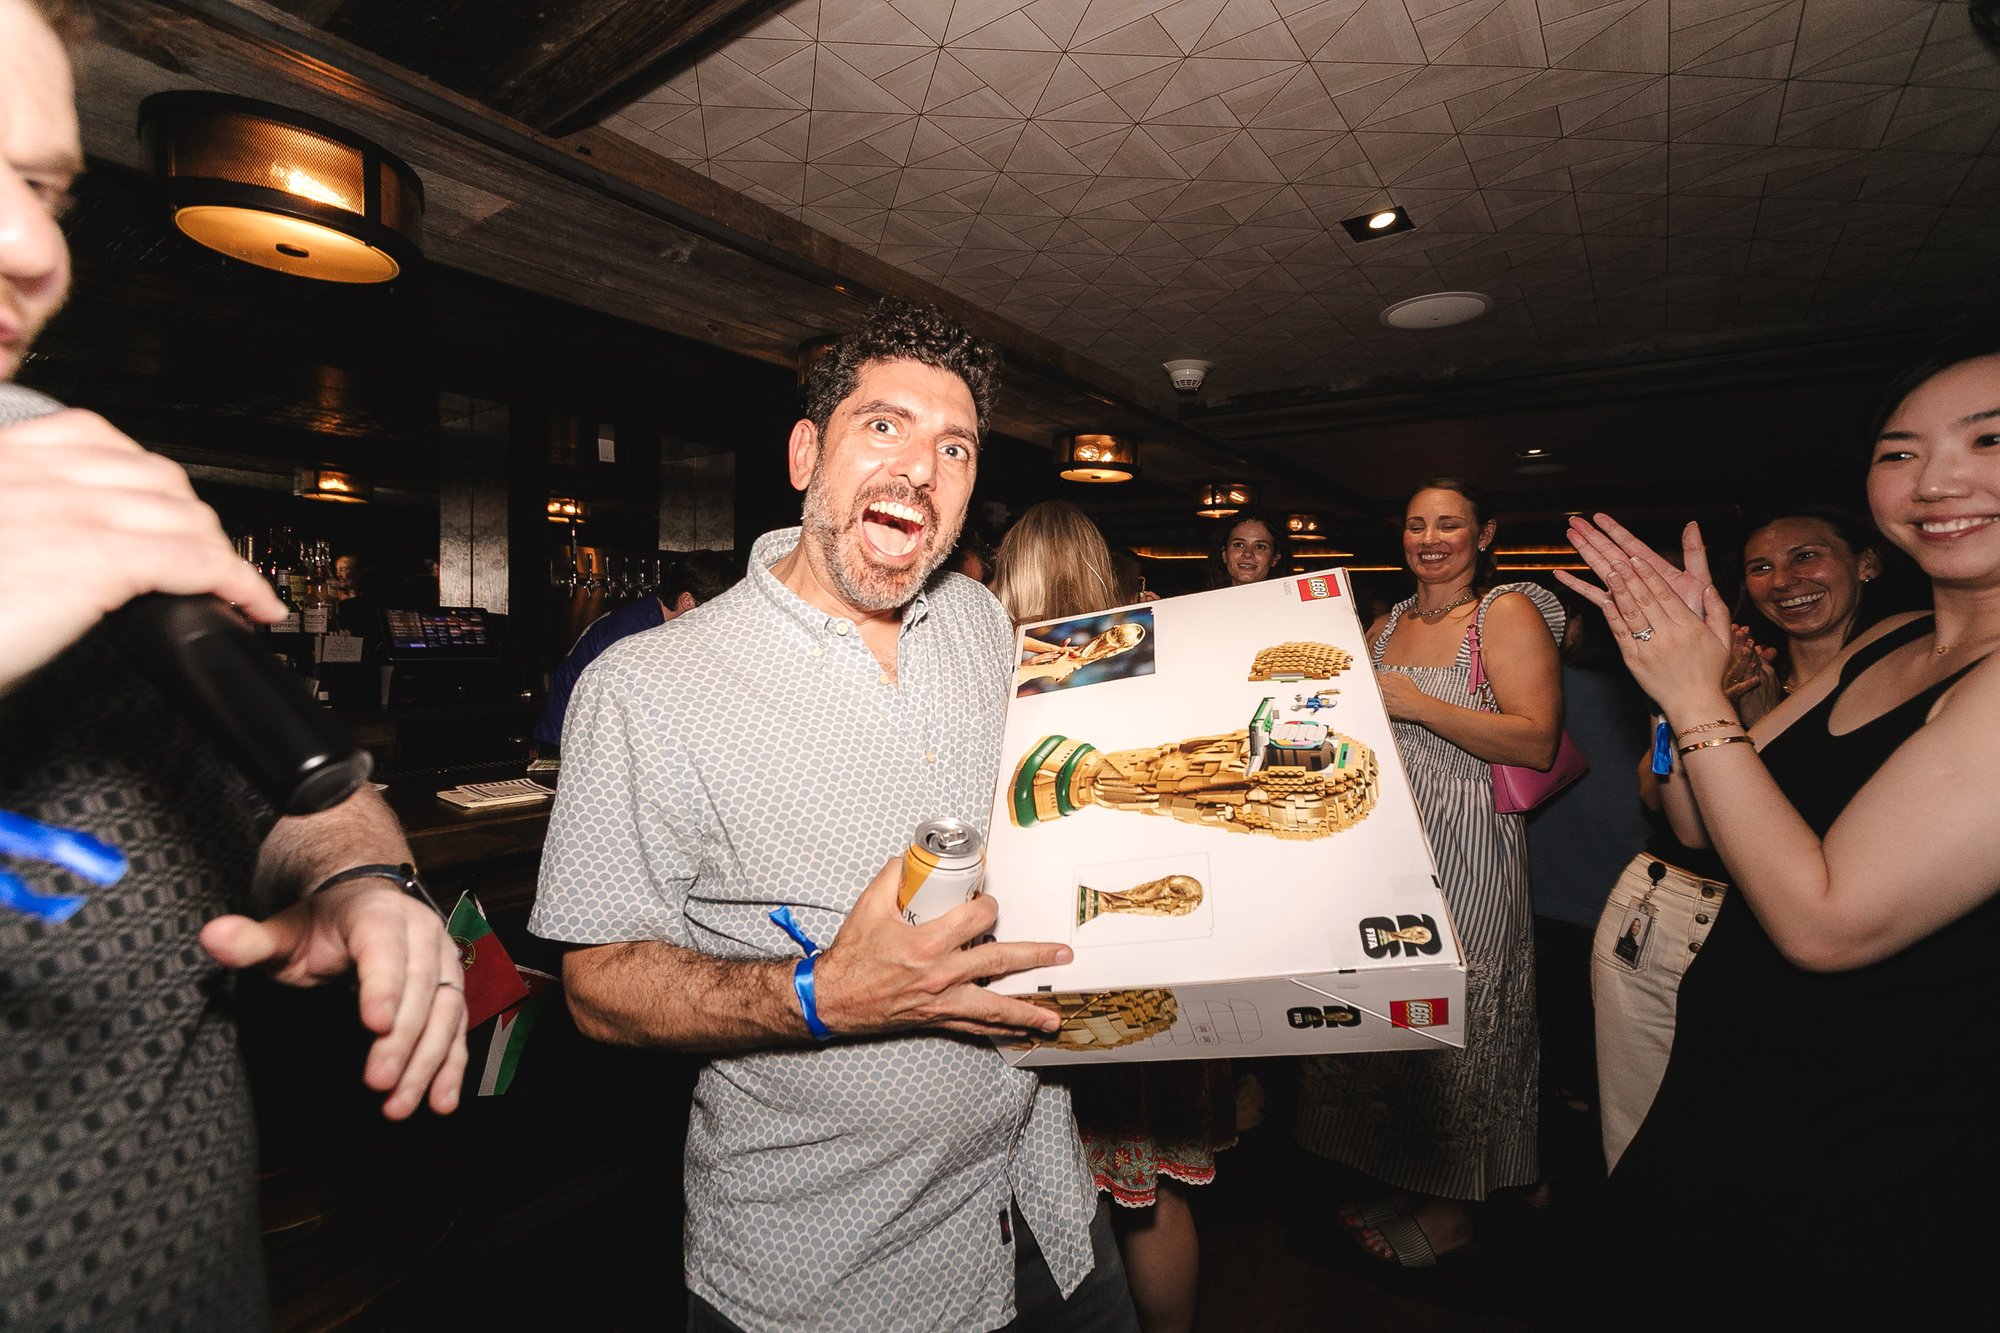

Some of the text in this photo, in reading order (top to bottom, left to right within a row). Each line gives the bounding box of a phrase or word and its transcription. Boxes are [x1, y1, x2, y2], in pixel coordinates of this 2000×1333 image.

[1309, 578, 1328, 598] LEGO
[1364, 927, 1379, 950] FIFA
[1293, 1013, 1303, 1025] FIFA
[1409, 1001, 1431, 1025] LEGO
